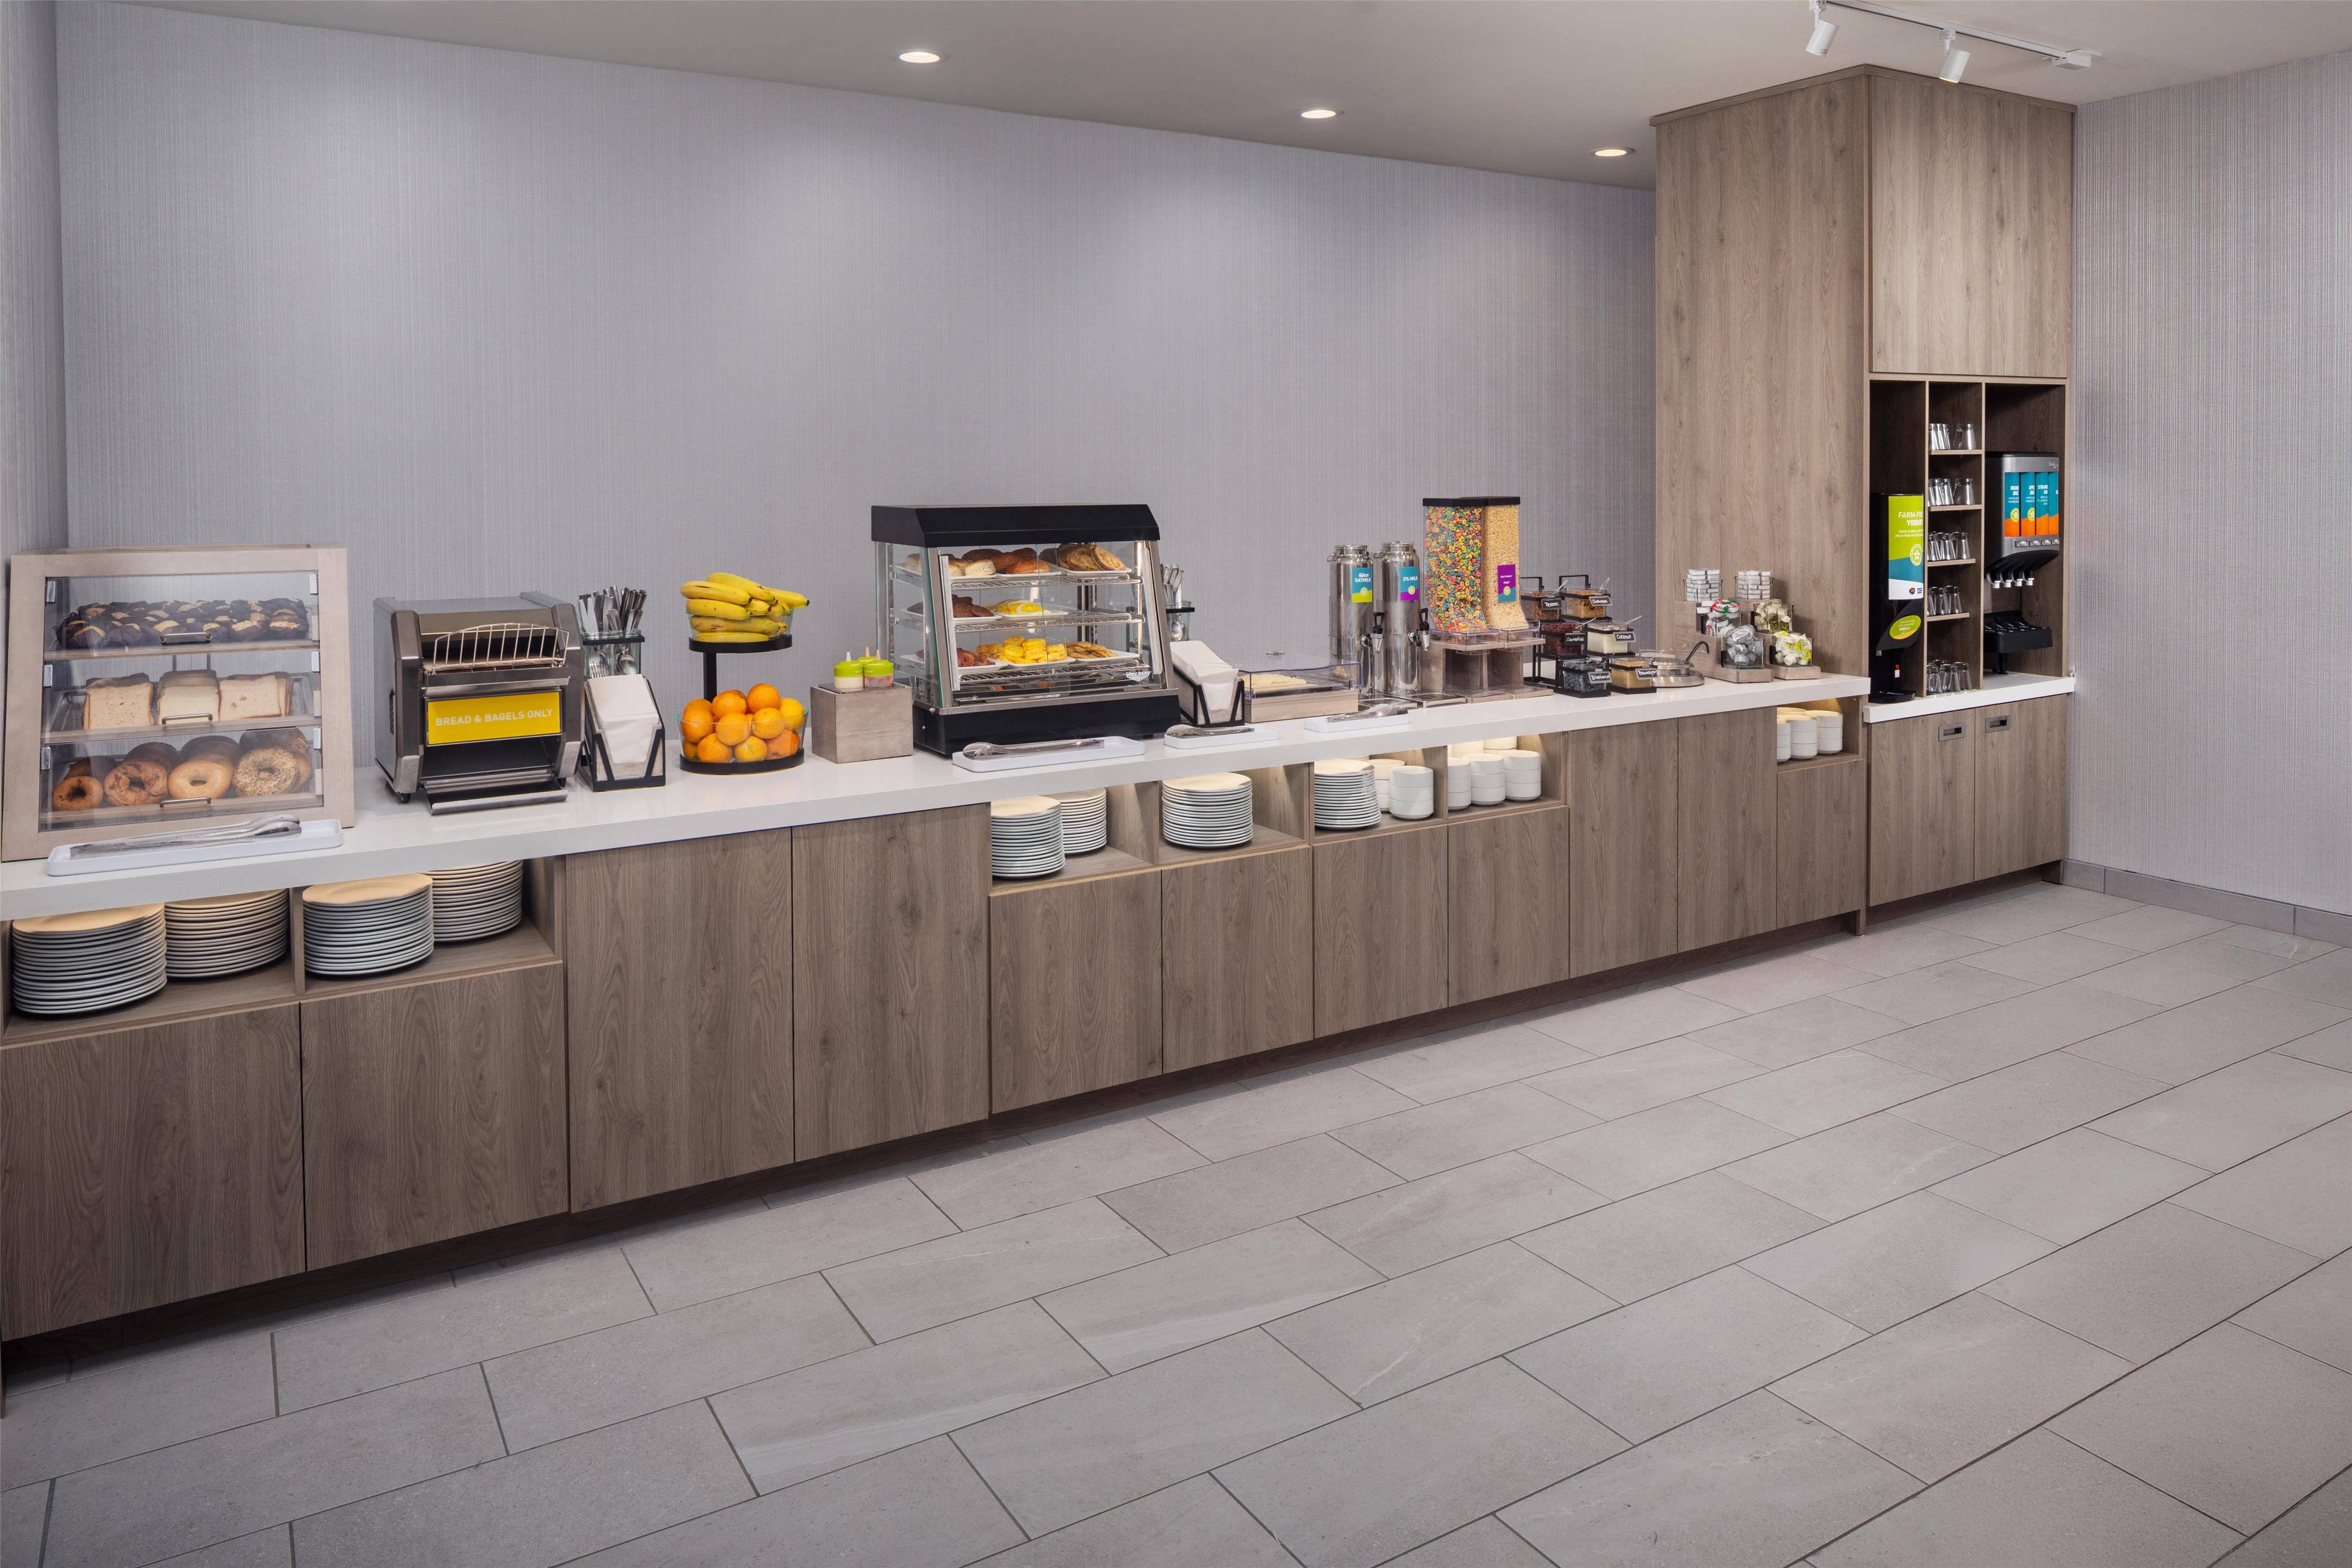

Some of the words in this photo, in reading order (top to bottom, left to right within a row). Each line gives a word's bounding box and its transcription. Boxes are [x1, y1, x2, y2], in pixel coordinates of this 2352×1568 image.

[436, 715, 472, 726] BREAD
[474, 714, 482, 723] &
[485, 710, 525, 722] BAGELS
[526, 708, 553, 719] ONLY
